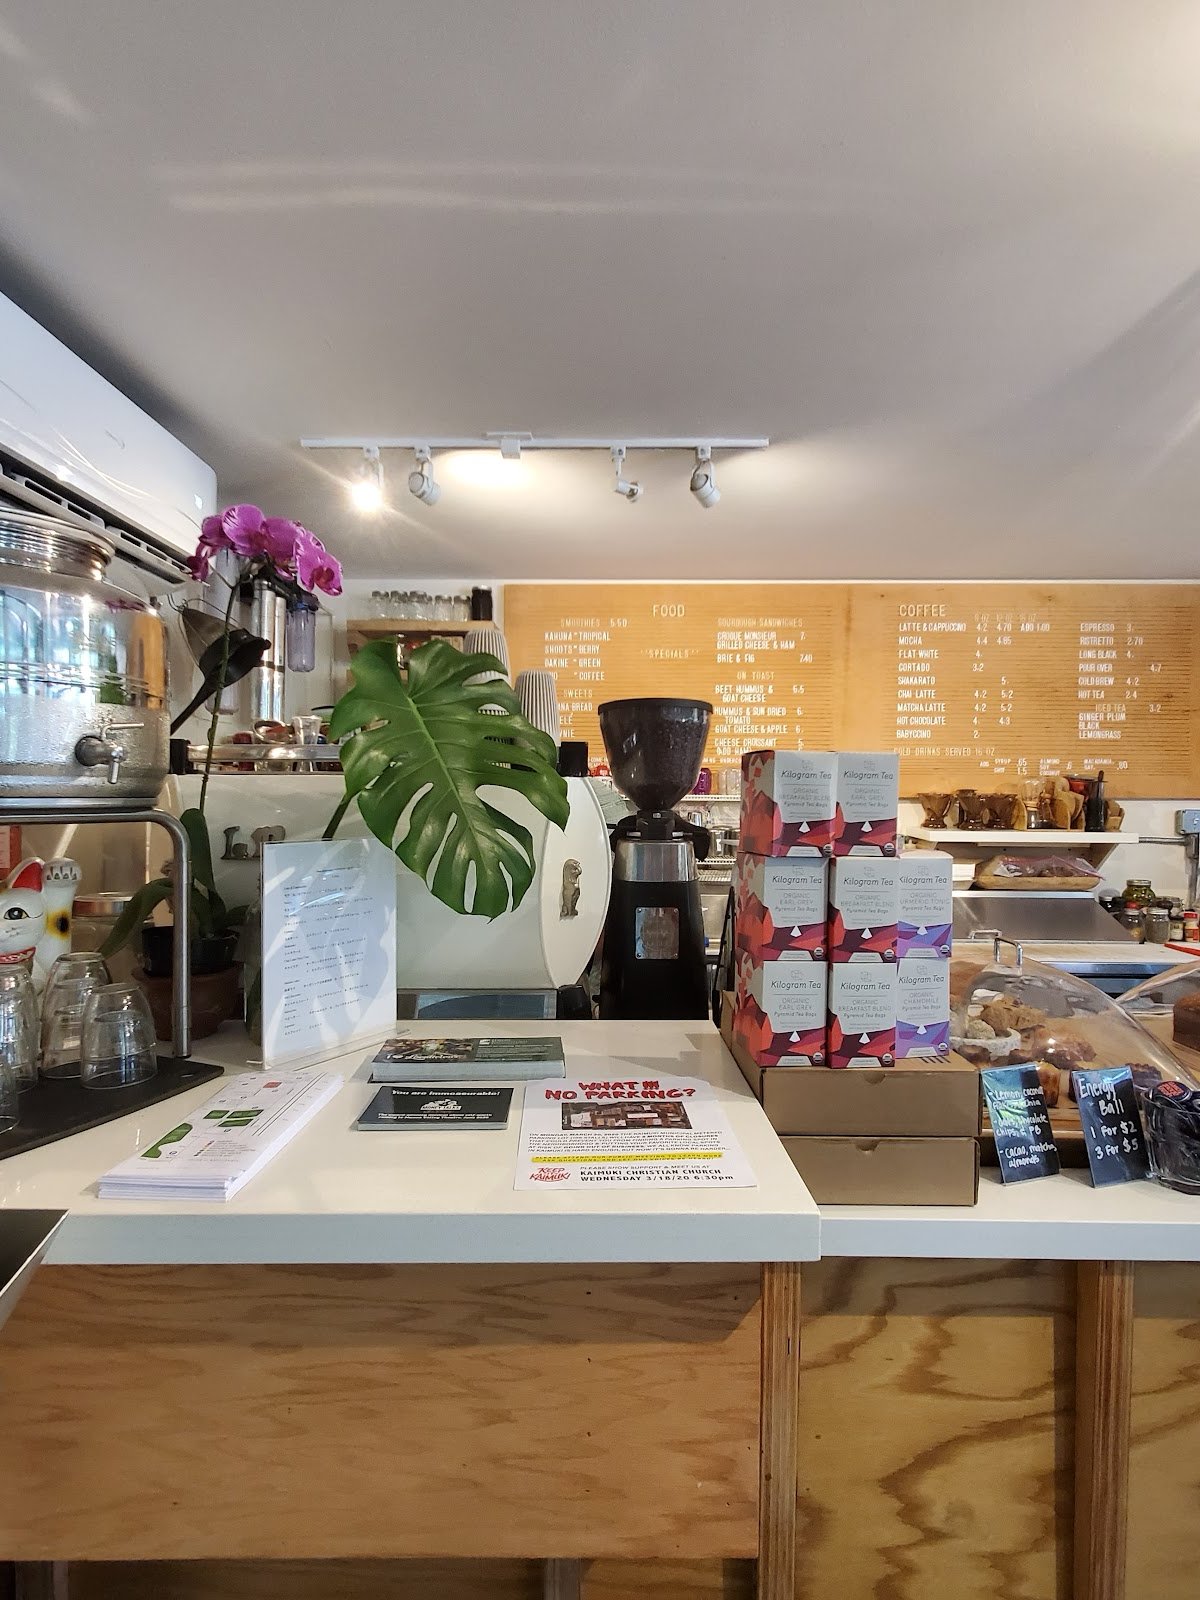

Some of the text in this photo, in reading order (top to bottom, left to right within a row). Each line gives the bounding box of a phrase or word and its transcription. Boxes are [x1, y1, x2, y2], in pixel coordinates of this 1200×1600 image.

[652, 604, 685, 617] FOOD
[898, 604, 946, 617] COFFEE
[899, 623, 921, 632] LATTE
[1080, 622, 1115, 632] ESPRESSO
[578, 632, 610, 641] TROPICAL
[744, 632, 776, 640] MONSIEUR
[898, 636, 922, 645] MOCHA
[716, 640, 743, 650] GRILLED
[744, 640, 770, 650] CHEESE
[780, 640, 796, 650] HAM
[1080, 636, 1114, 646] RISTRETTO
[578, 645, 600, 654] BERRY
[898, 650, 939, 658] FLAT WHITE
[716, 654, 734, 663] BRIE
[1079, 650, 1117, 659] LONG BLACK
[578, 658, 600, 668] GREEN
[898, 662, 930, 672] CORTADO
[1078, 664, 1096, 672] POUR
[1096, 664, 1112, 672] OVER
[579, 672, 605, 681] COFFEE
[752, 672, 774, 680] TOAST
[1096, 676, 1114, 686] BREW
[564, 688, 592, 698] SWEETS
[715, 684, 732, 694] BEET
[736, 684, 764, 694] HUMMUS
[722, 694, 766, 703] GOAT CHEESE
[916, 690, 936, 698] LATTE
[1078, 690, 1090, 699] HOT
[1092, 690, 1104, 699] TEA
[713, 707, 742, 716] HUMMUS
[897, 702, 924, 712] MATCHA
[925, 702, 946, 712] LATTE
[1114, 704, 1126, 712] TEA
[725, 716, 750, 724] TOMATO
[910, 716, 946, 725] CHOCOLATE
[1078, 712, 1126, 720] GINGER PLUM
[715, 725, 731, 734] GOAT
[734, 725, 758, 734] CHEESE
[766, 725, 788, 734] APPLE
[1078, 722, 1100, 730] BLACK
[1078, 730, 1121, 739] LEMONGRASS
[714, 738, 776, 747] CHEESE CROISSANT
[915, 748, 940, 756] DRINKS
[946, 748, 971, 756] SERVED
[781, 770, 832, 780] Kilogram Tea
[844, 770, 894, 780] Kilogram Tea
[772, 876, 808, 885] Kilogram
[844, 878, 878, 887] Kilogram
[771, 980, 807, 991] Kilogram
[840, 982, 876, 992] Kilogram
[1080, 1078, 1116, 1100] Energy
[545, 1088, 696, 1100] NO PARKING?
[1099, 1098, 1124, 1116] Ball
[1090, 1126, 1096, 1138] 1
[1120, 1120, 1137, 1134] $2
[1095, 1146, 1104, 1160] 3
[1122, 1137, 1138, 1152] $5
[1008, 1154, 1040, 1168] almonds
[530, 1172, 570, 1182] KAIMUKI
